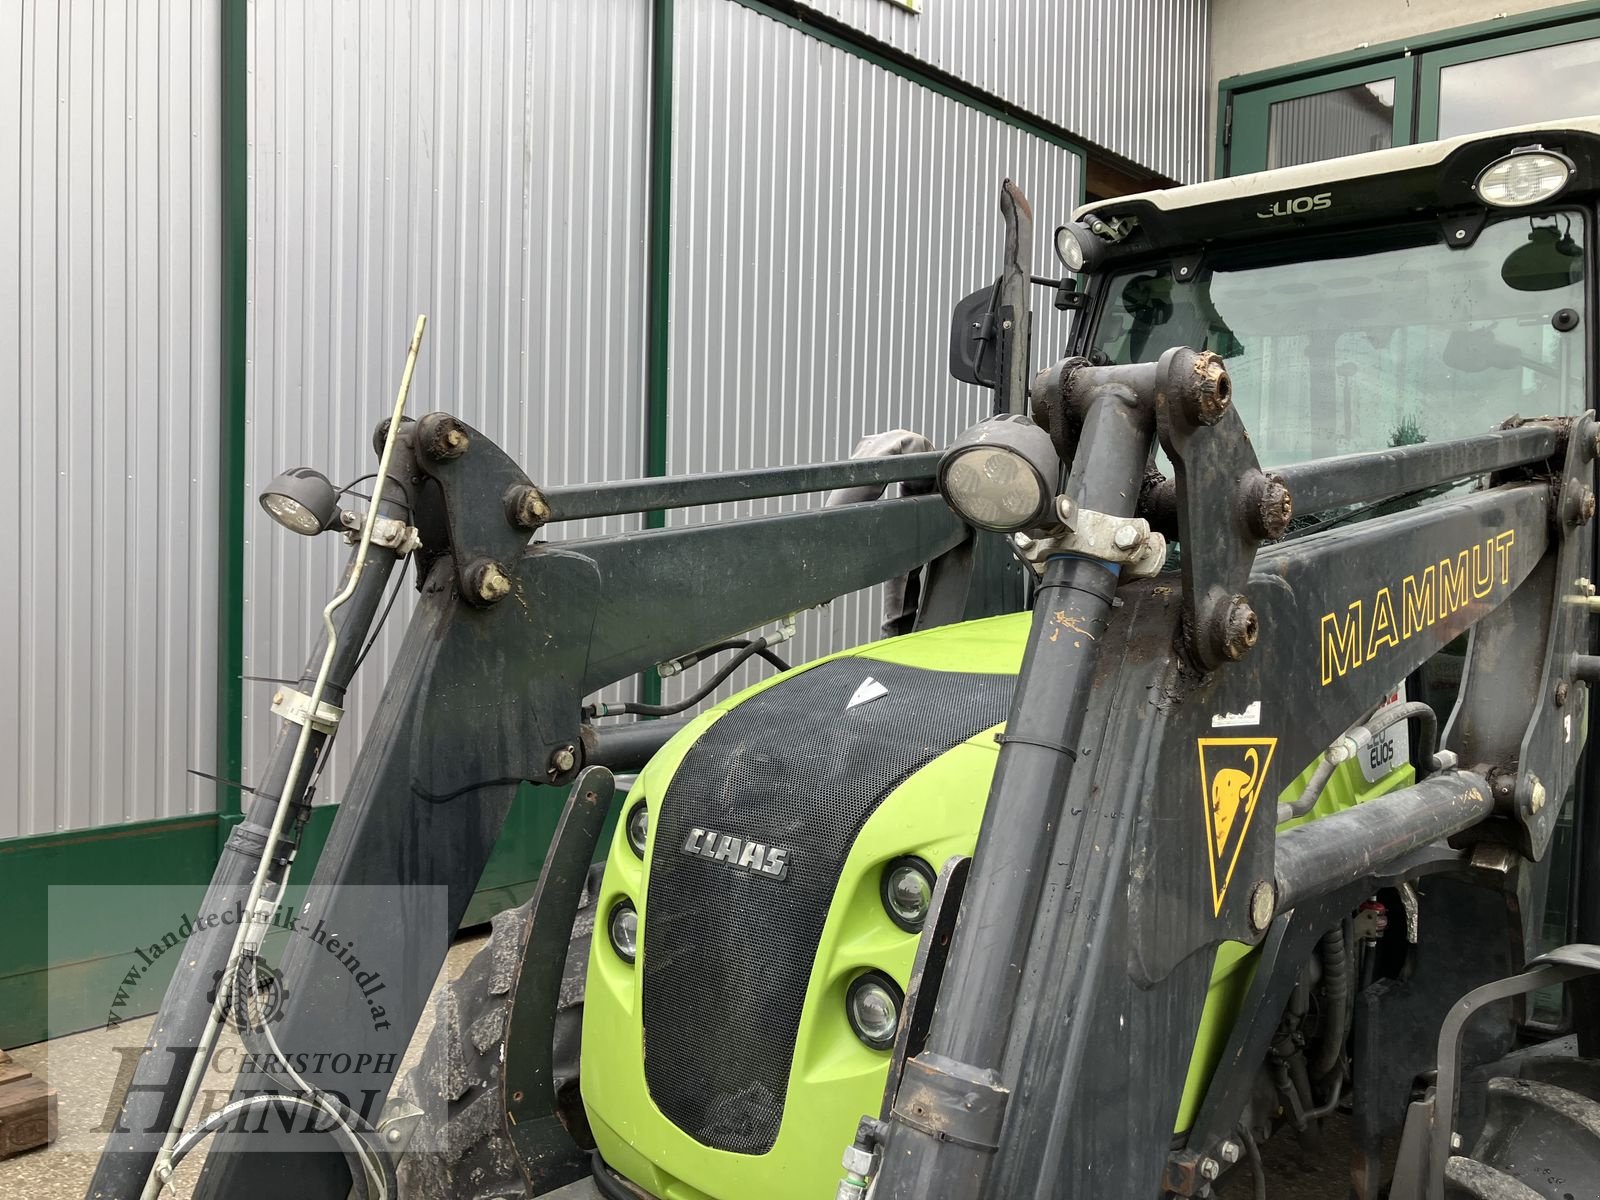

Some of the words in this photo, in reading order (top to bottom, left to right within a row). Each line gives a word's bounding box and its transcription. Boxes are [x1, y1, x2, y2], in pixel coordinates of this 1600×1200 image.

[1321, 529, 1515, 686] MAMMUT
[1370, 739, 1394, 769] ELIOS
[684, 828, 789, 876] CLAAS
